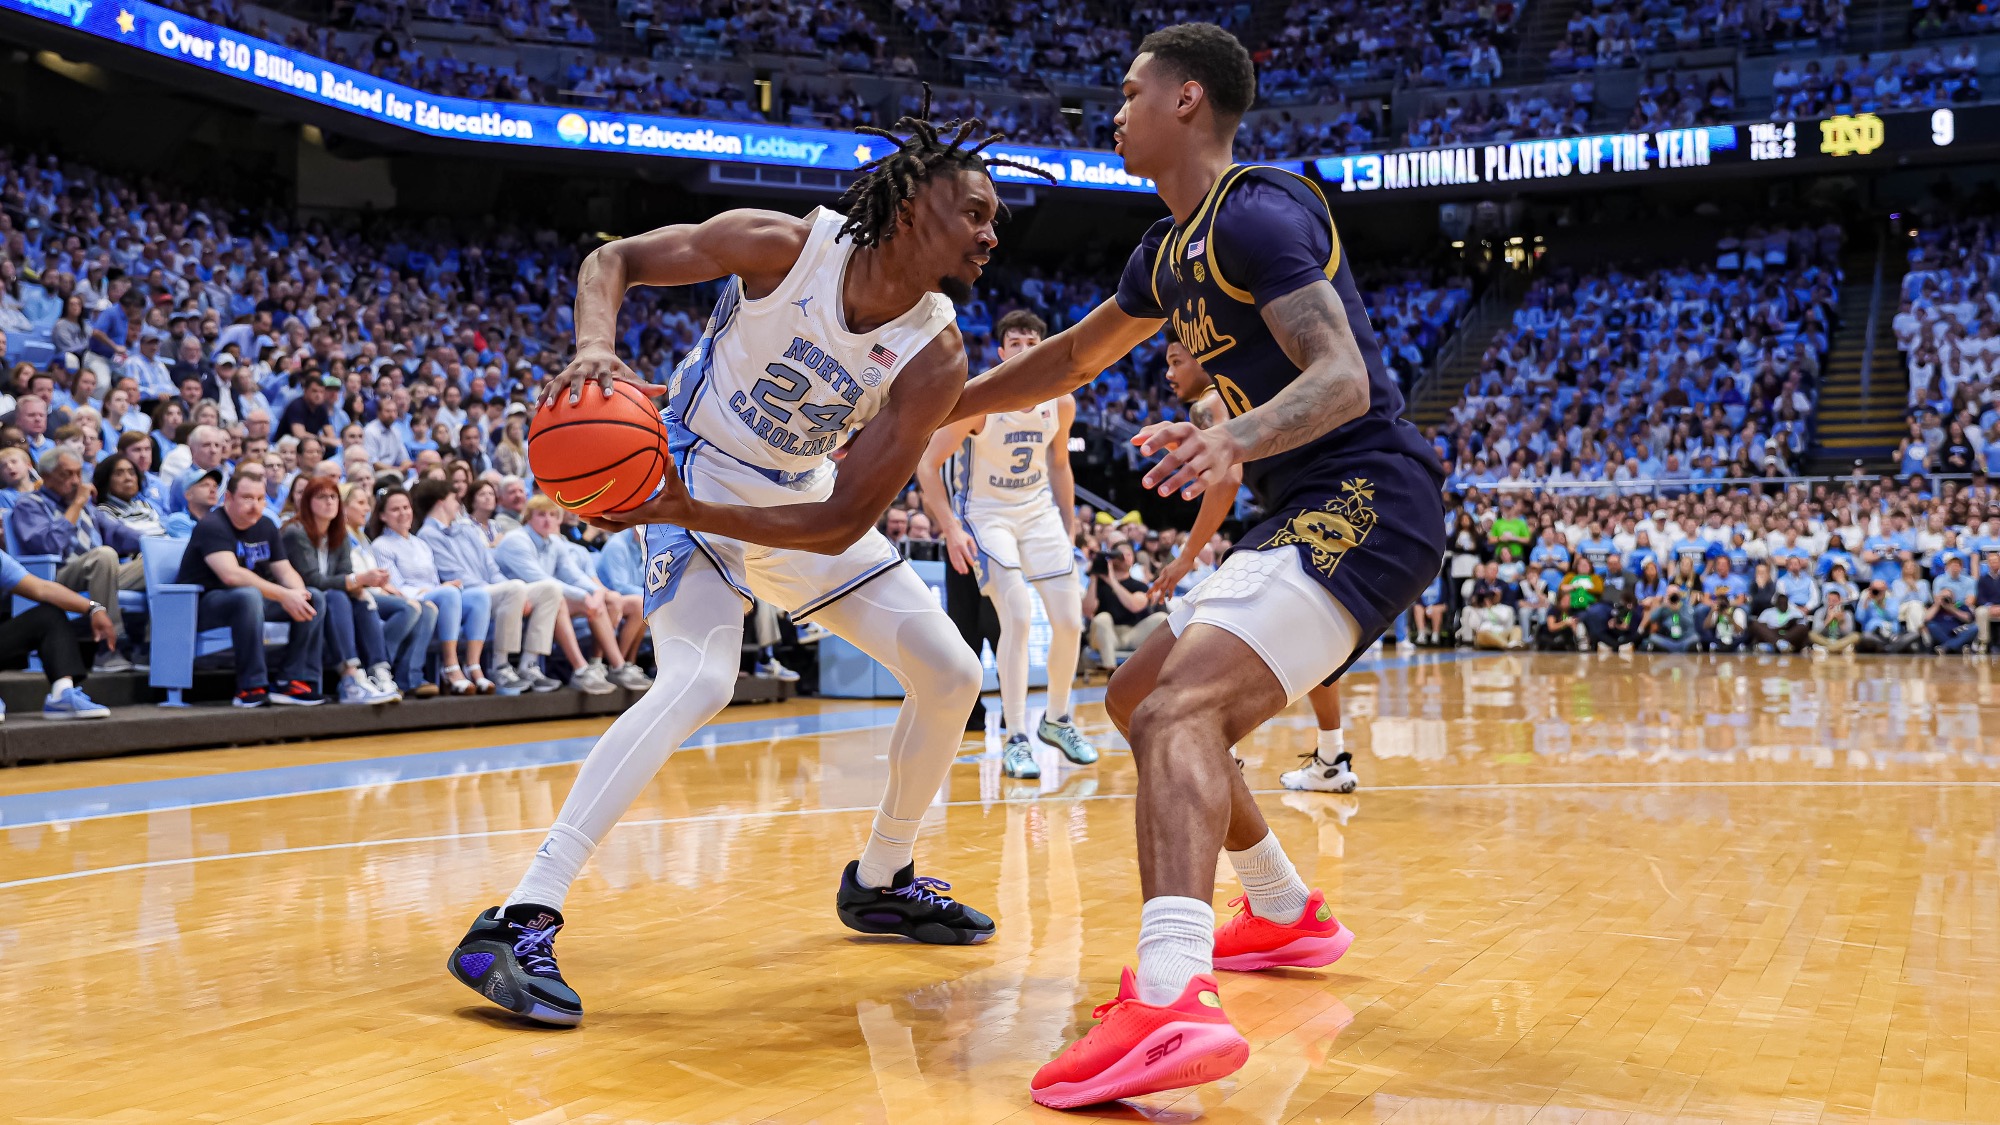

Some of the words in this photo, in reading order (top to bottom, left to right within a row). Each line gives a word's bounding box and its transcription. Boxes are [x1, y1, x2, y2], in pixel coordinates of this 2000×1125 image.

[158, 20, 215, 61] Over
[219, 37, 251, 72] $10
[254, 48, 317, 93] Billion
[321, 70, 382, 113] Raised
[385, 93, 413, 122] for
[415, 100, 533, 139] Education
[589, 121, 625, 144] NC
[627, 123, 742, 154] Education
[744, 134, 826, 164] Lottery
[1931, 108, 1954, 146] 9
[1341, 155, 1382, 192] 13
[1383, 148, 1479, 190] NATIONAL
[1484, 138, 1572, 182] PLAYERS
[1578, 136, 1604, 175] OF
[1610, 133, 1650, 172] THE
[1655, 128, 1710, 169] YEAR
[750, 363, 855, 432] 24
[783, 336, 864, 406] NORTH
[728, 390, 837, 456] CAROLINA
[1003, 431, 1043, 445] NORTH
[989, 469, 1042, 488] CAROLINA
[1010, 446, 1034, 474] 3
